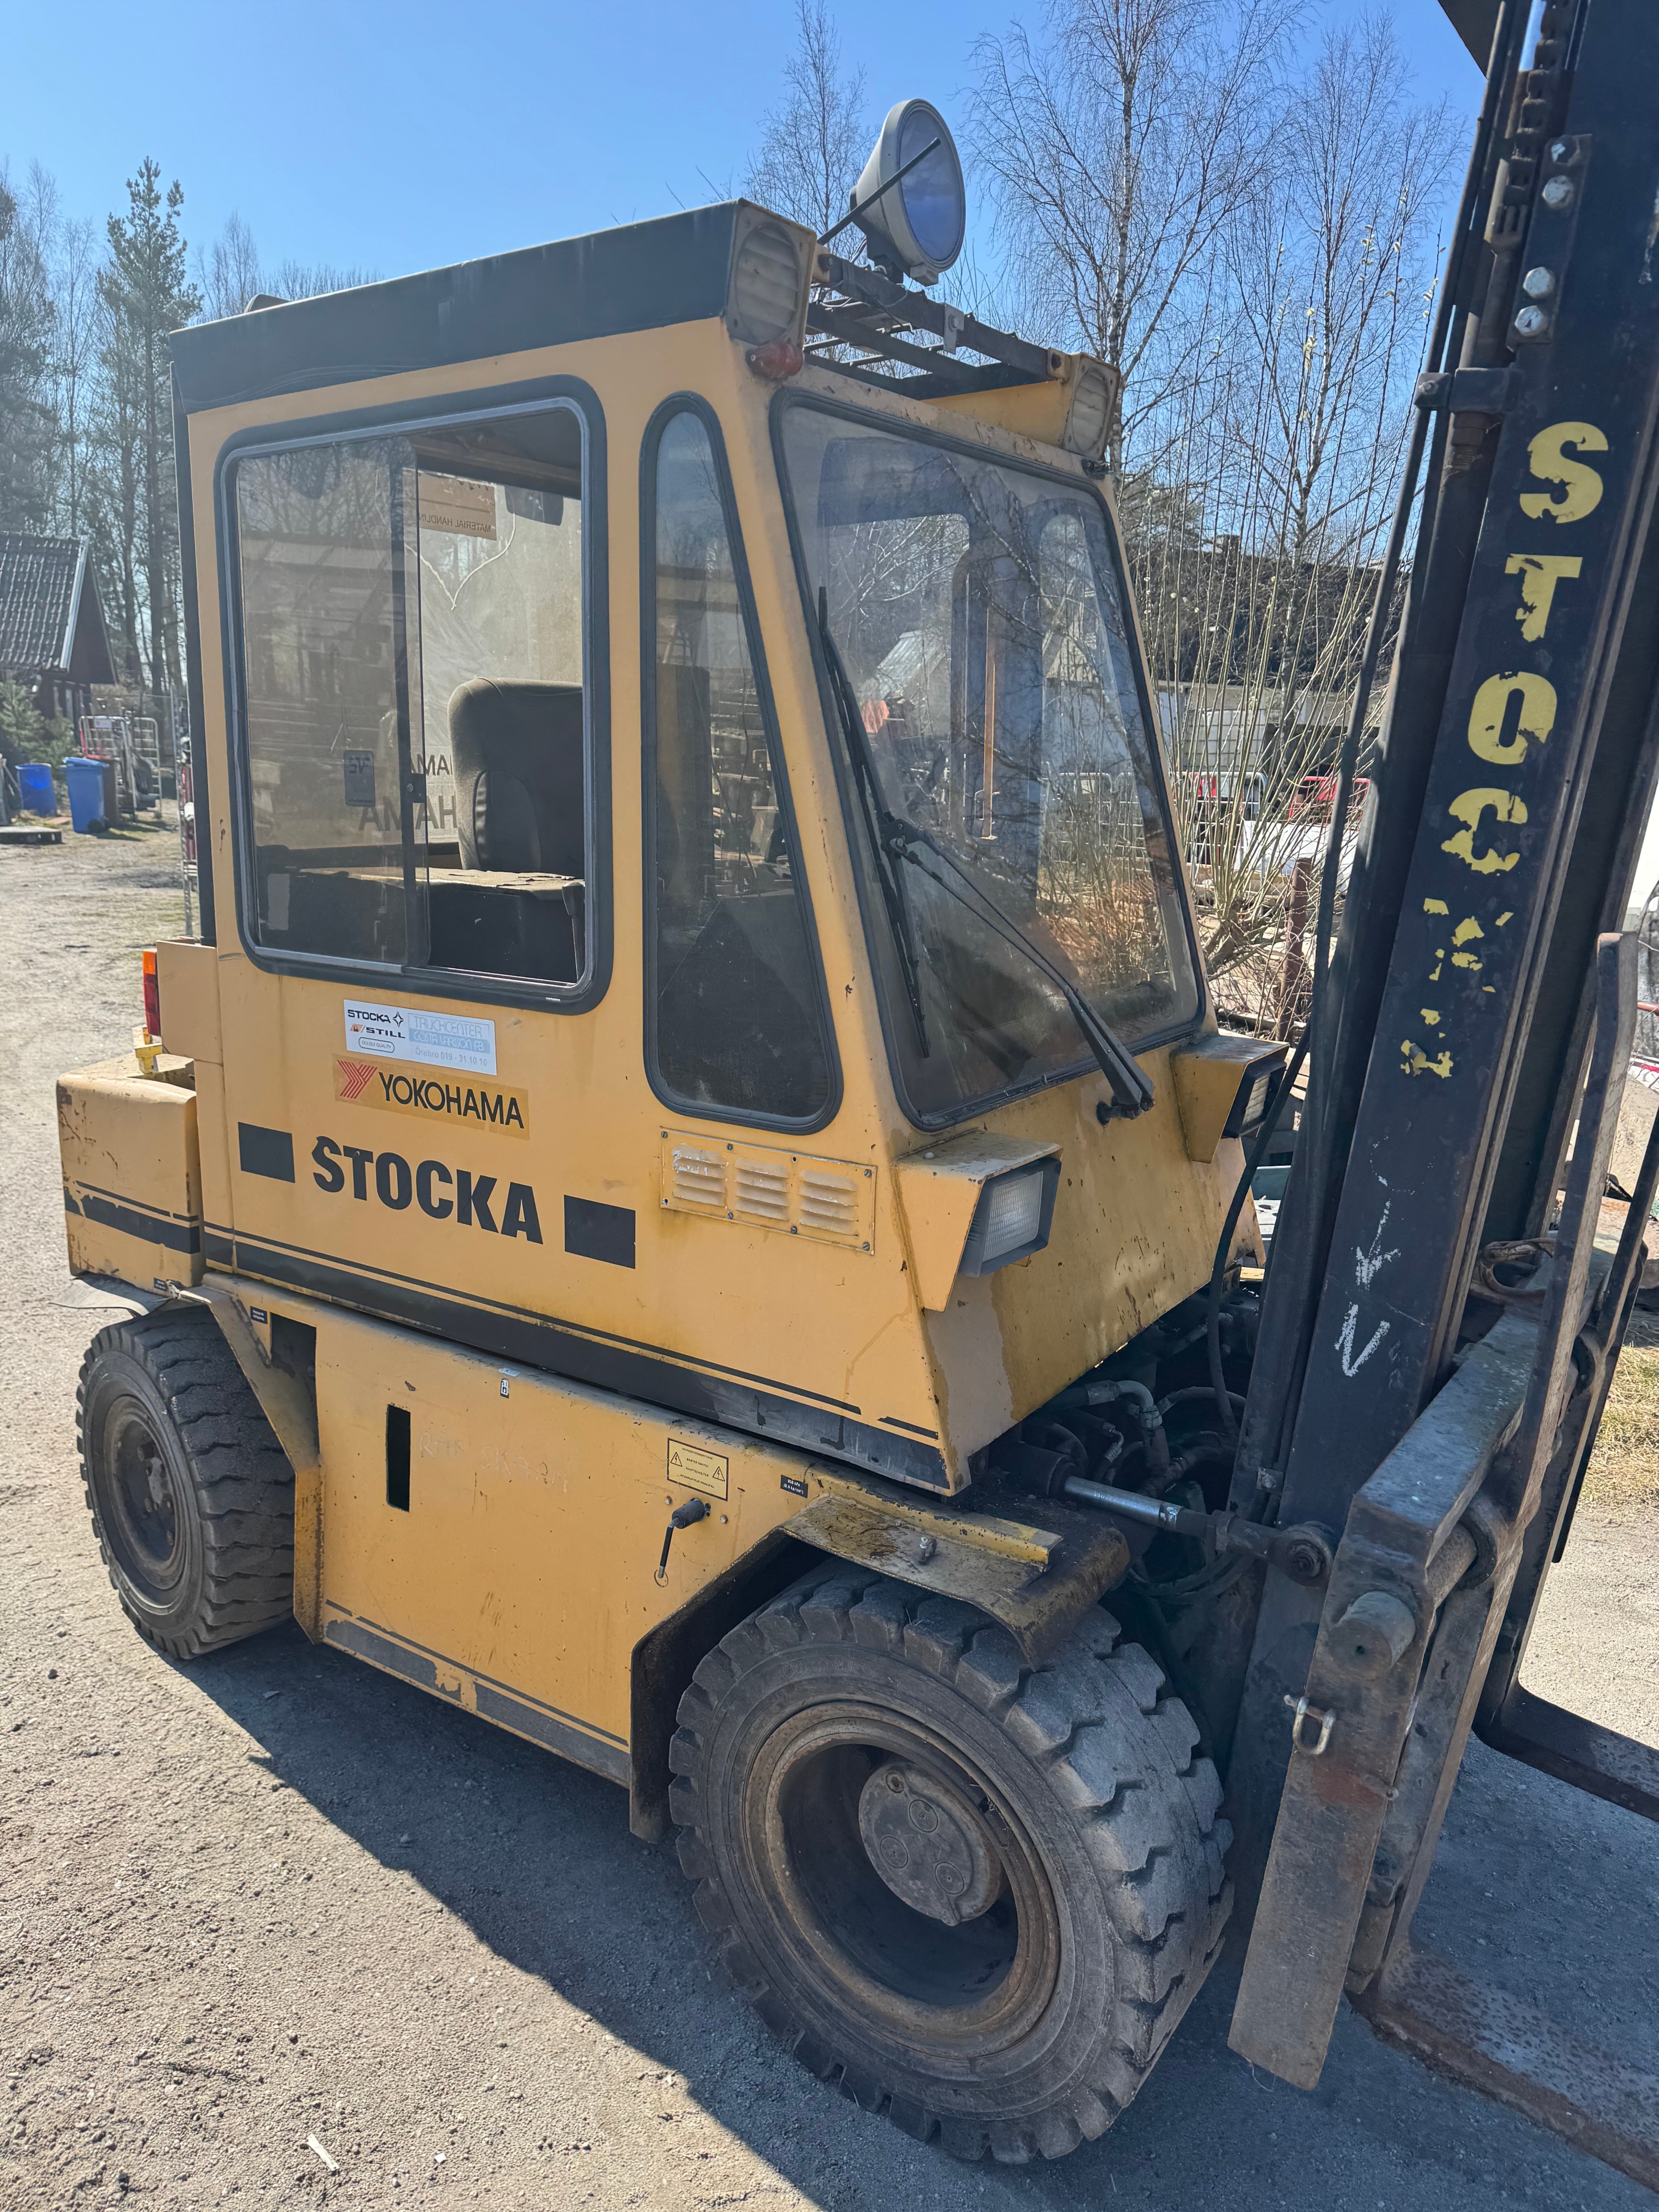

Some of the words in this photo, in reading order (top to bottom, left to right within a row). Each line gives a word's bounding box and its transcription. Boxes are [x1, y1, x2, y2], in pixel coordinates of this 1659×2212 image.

[347, 1009, 391, 1024] STOCKA
[366, 1026, 406, 1039] STILL
[413, 1015, 483, 1039] TRUCKCENTER
[440, 1034, 472, 1050] LARSSON
[474, 1040, 484, 1051] AB
[440, 1051, 453, 1061] 019
[459, 1054, 467, 1063] 31
[469, 1056, 477, 1065] 10
[479, 1058, 488, 1066] 10
[378, 1071, 525, 1129] YOKOHAMA
[311, 1135, 544, 1245] STOCKA
